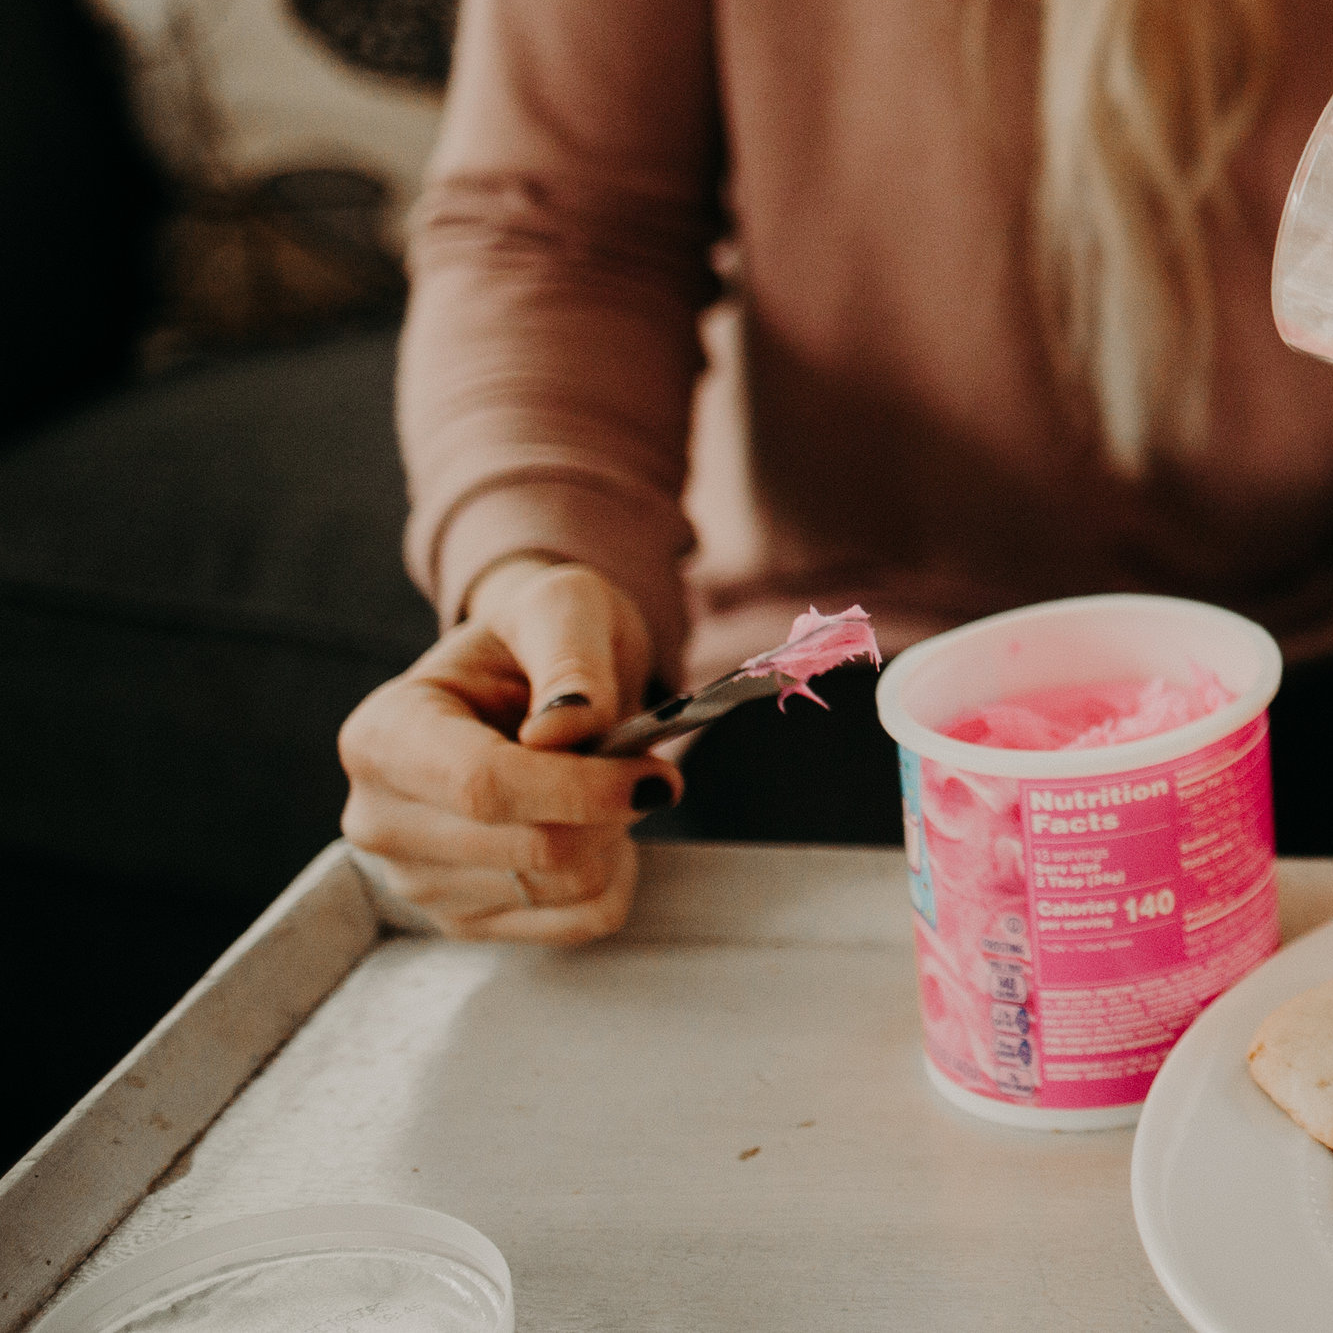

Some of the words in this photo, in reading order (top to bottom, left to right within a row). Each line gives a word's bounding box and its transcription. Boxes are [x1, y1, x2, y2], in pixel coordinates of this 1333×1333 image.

[1029, 779, 1169, 811] Nutrition
[1031, 812, 1120, 835] Facts
[1052, 847, 1110, 865] servings
[1036, 898, 1119, 917] Calories
[1123, 888, 1176, 924] 140
